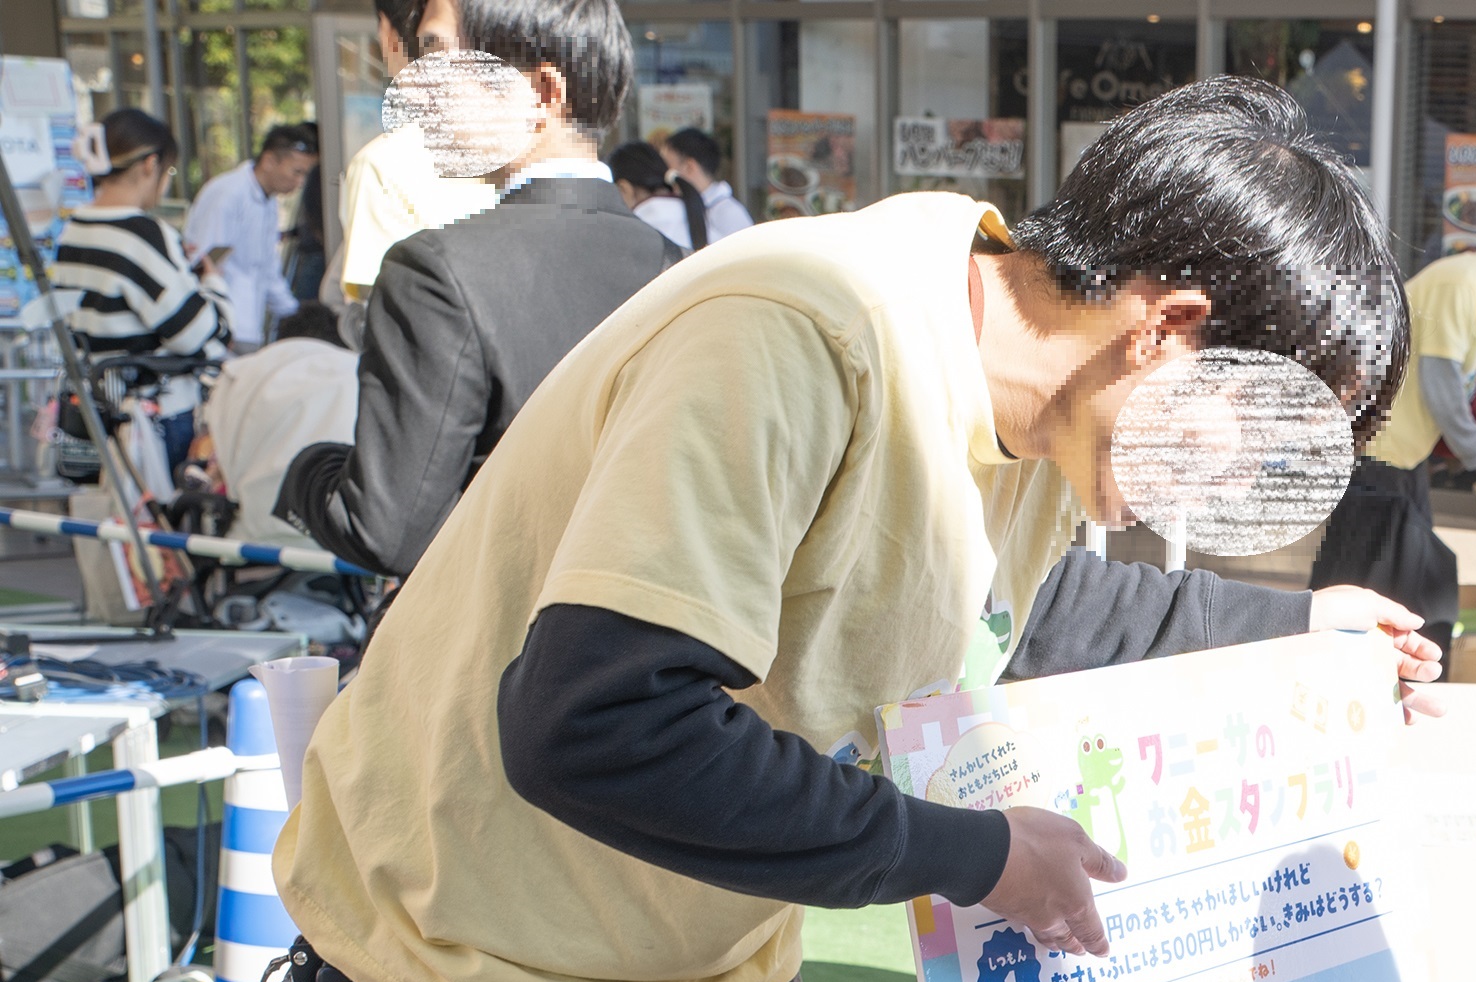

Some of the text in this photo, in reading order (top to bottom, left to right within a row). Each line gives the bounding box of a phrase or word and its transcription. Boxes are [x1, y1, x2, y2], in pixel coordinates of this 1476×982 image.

[950, 741, 1016, 782] さんかしてくれた
[1137, 712, 1276, 786] ワニーサの
[958, 759, 1018, 800] おともだちには
[988, 949, 1027, 972] しつもん
